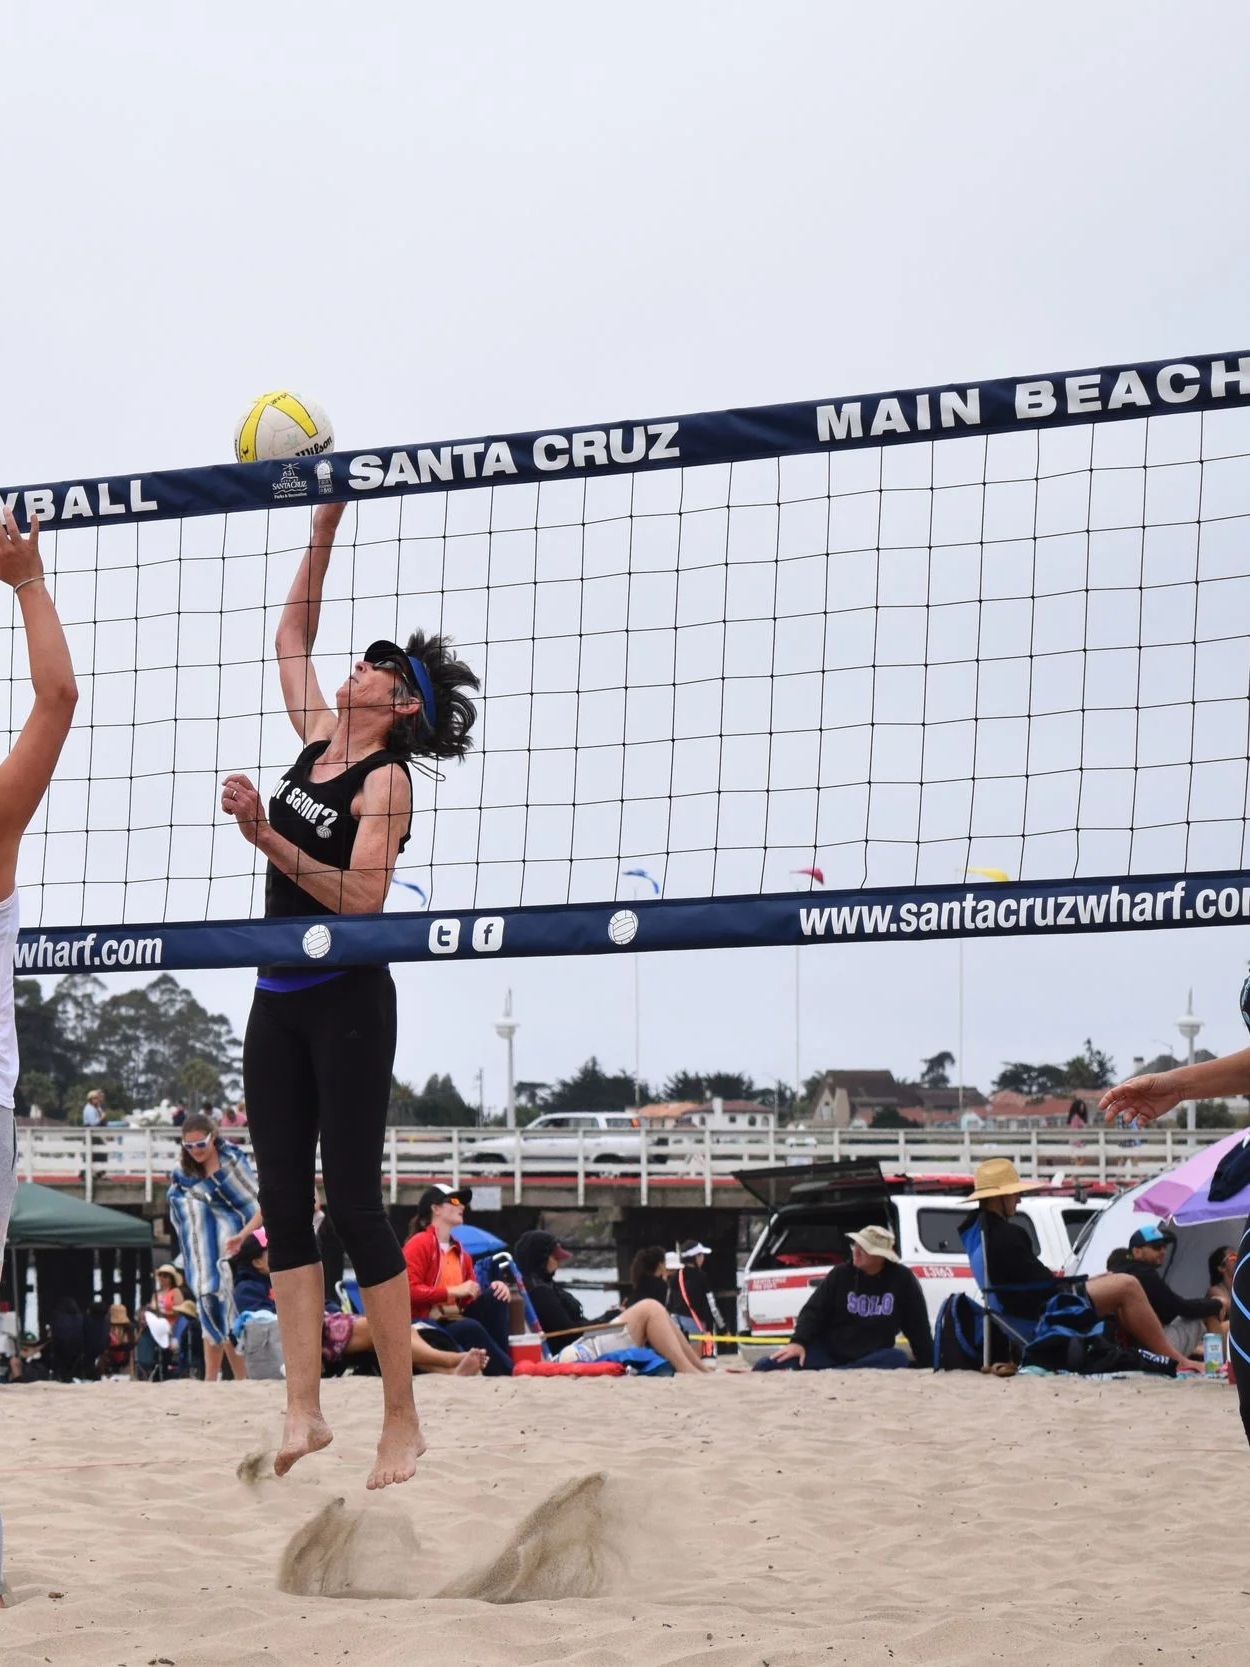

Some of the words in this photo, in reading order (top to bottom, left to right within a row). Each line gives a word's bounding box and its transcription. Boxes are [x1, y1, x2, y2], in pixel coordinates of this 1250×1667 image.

[816, 387, 981, 442] MAIN
[1014, 356, 1250, 419] BEACH
[348, 441, 518, 490] SANTA
[532, 421, 680, 471] CRUZ
[799, 880, 1250, 936] www.santacruzwharf.co
